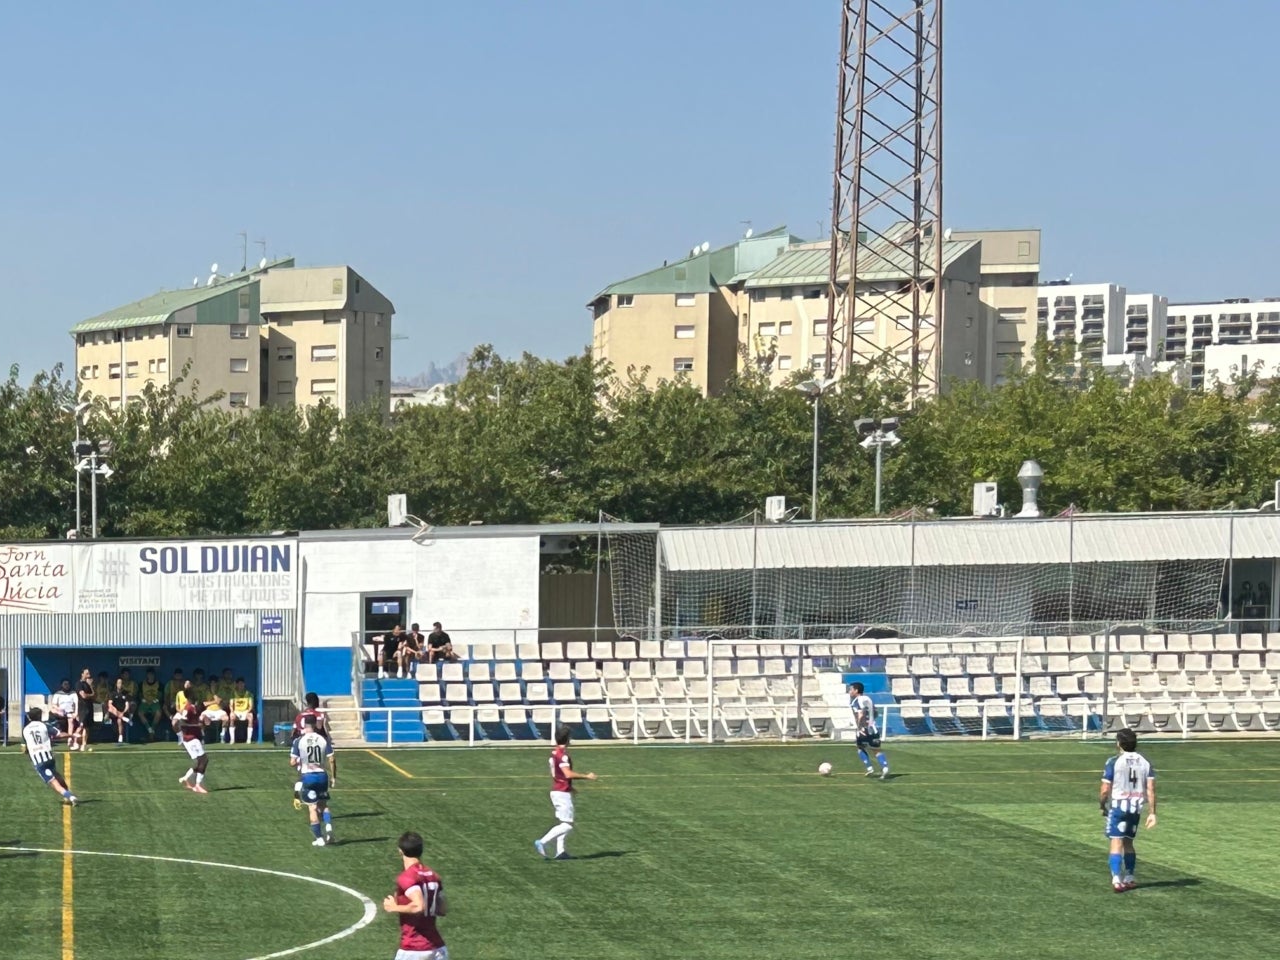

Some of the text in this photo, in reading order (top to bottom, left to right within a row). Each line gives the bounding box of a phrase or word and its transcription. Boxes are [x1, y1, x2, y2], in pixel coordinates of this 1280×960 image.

[307, 745, 321, 763] 20
[1128, 767, 1138, 789] 4
[423, 882, 439, 917] 17
